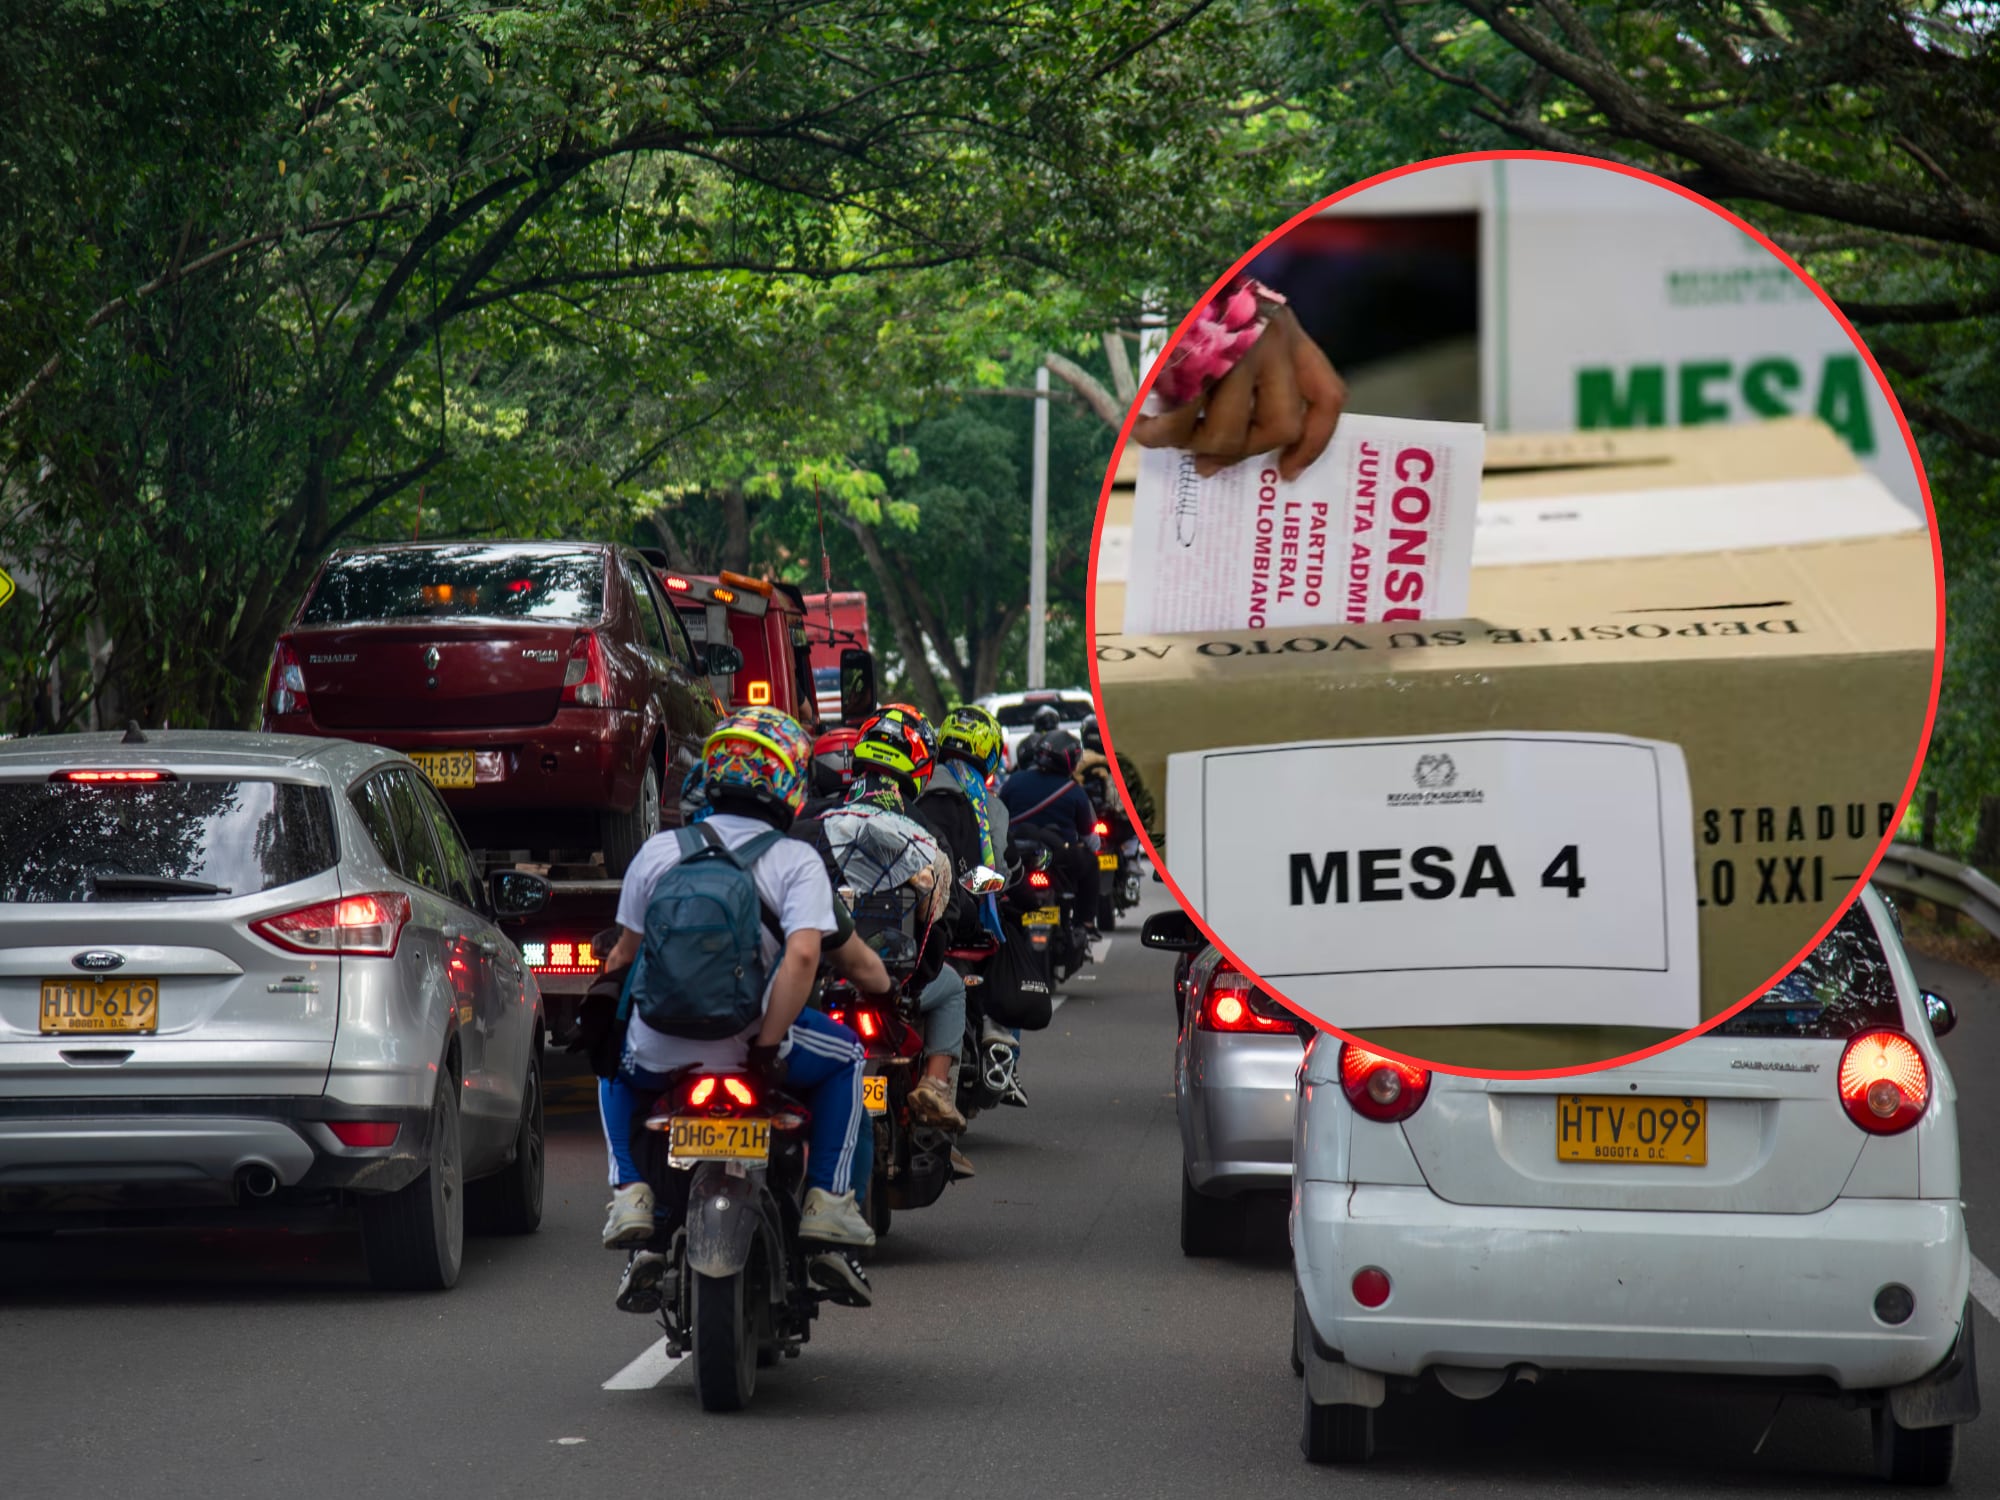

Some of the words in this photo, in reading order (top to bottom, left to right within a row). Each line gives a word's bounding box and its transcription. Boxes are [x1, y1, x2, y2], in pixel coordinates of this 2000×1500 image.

[1576, 353, 1876, 457] MESA
[1354, 442, 1379, 533] JUNTA
[1248, 469, 1277, 629] COLOMBIANO
[1277, 502, 1301, 603] LIBERAL
[1304, 502, 1328, 607] PARTIDO
[1196, 635, 1372, 656] VOTO
[1389, 629, 1467, 649] SU
[1487, 618, 1803, 644] DEPOSITE
[1290, 845, 1516, 906] MESA
[1541, 845, 1586, 898] 4
[1698, 859, 1735, 907] O
[1756, 855, 1824, 905] XXI
[1595, 1147, 1639, 1158] BOGOTA
